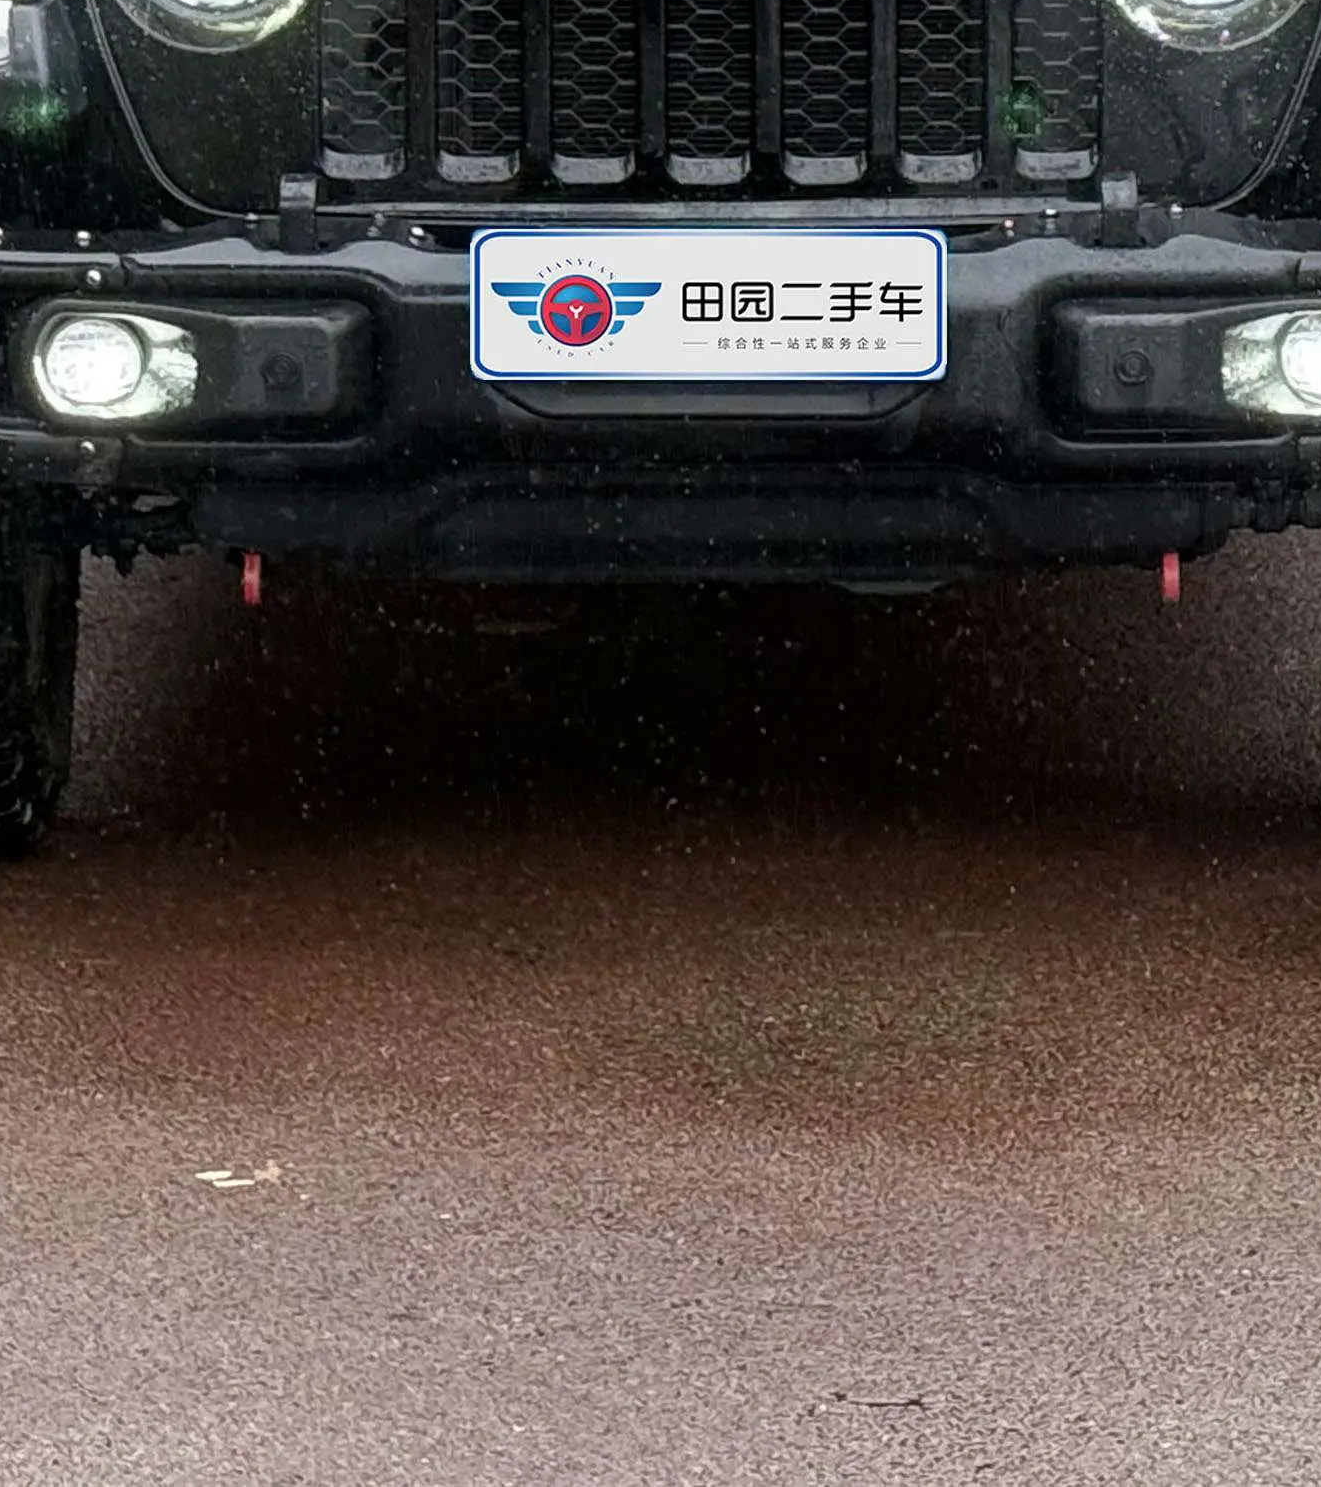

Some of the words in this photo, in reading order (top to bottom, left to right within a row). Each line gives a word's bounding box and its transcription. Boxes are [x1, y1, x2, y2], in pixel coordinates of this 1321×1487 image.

[681, 281, 924, 323] 田园二手车
[717, 336, 887, 351] 综合性一站式服务企业
